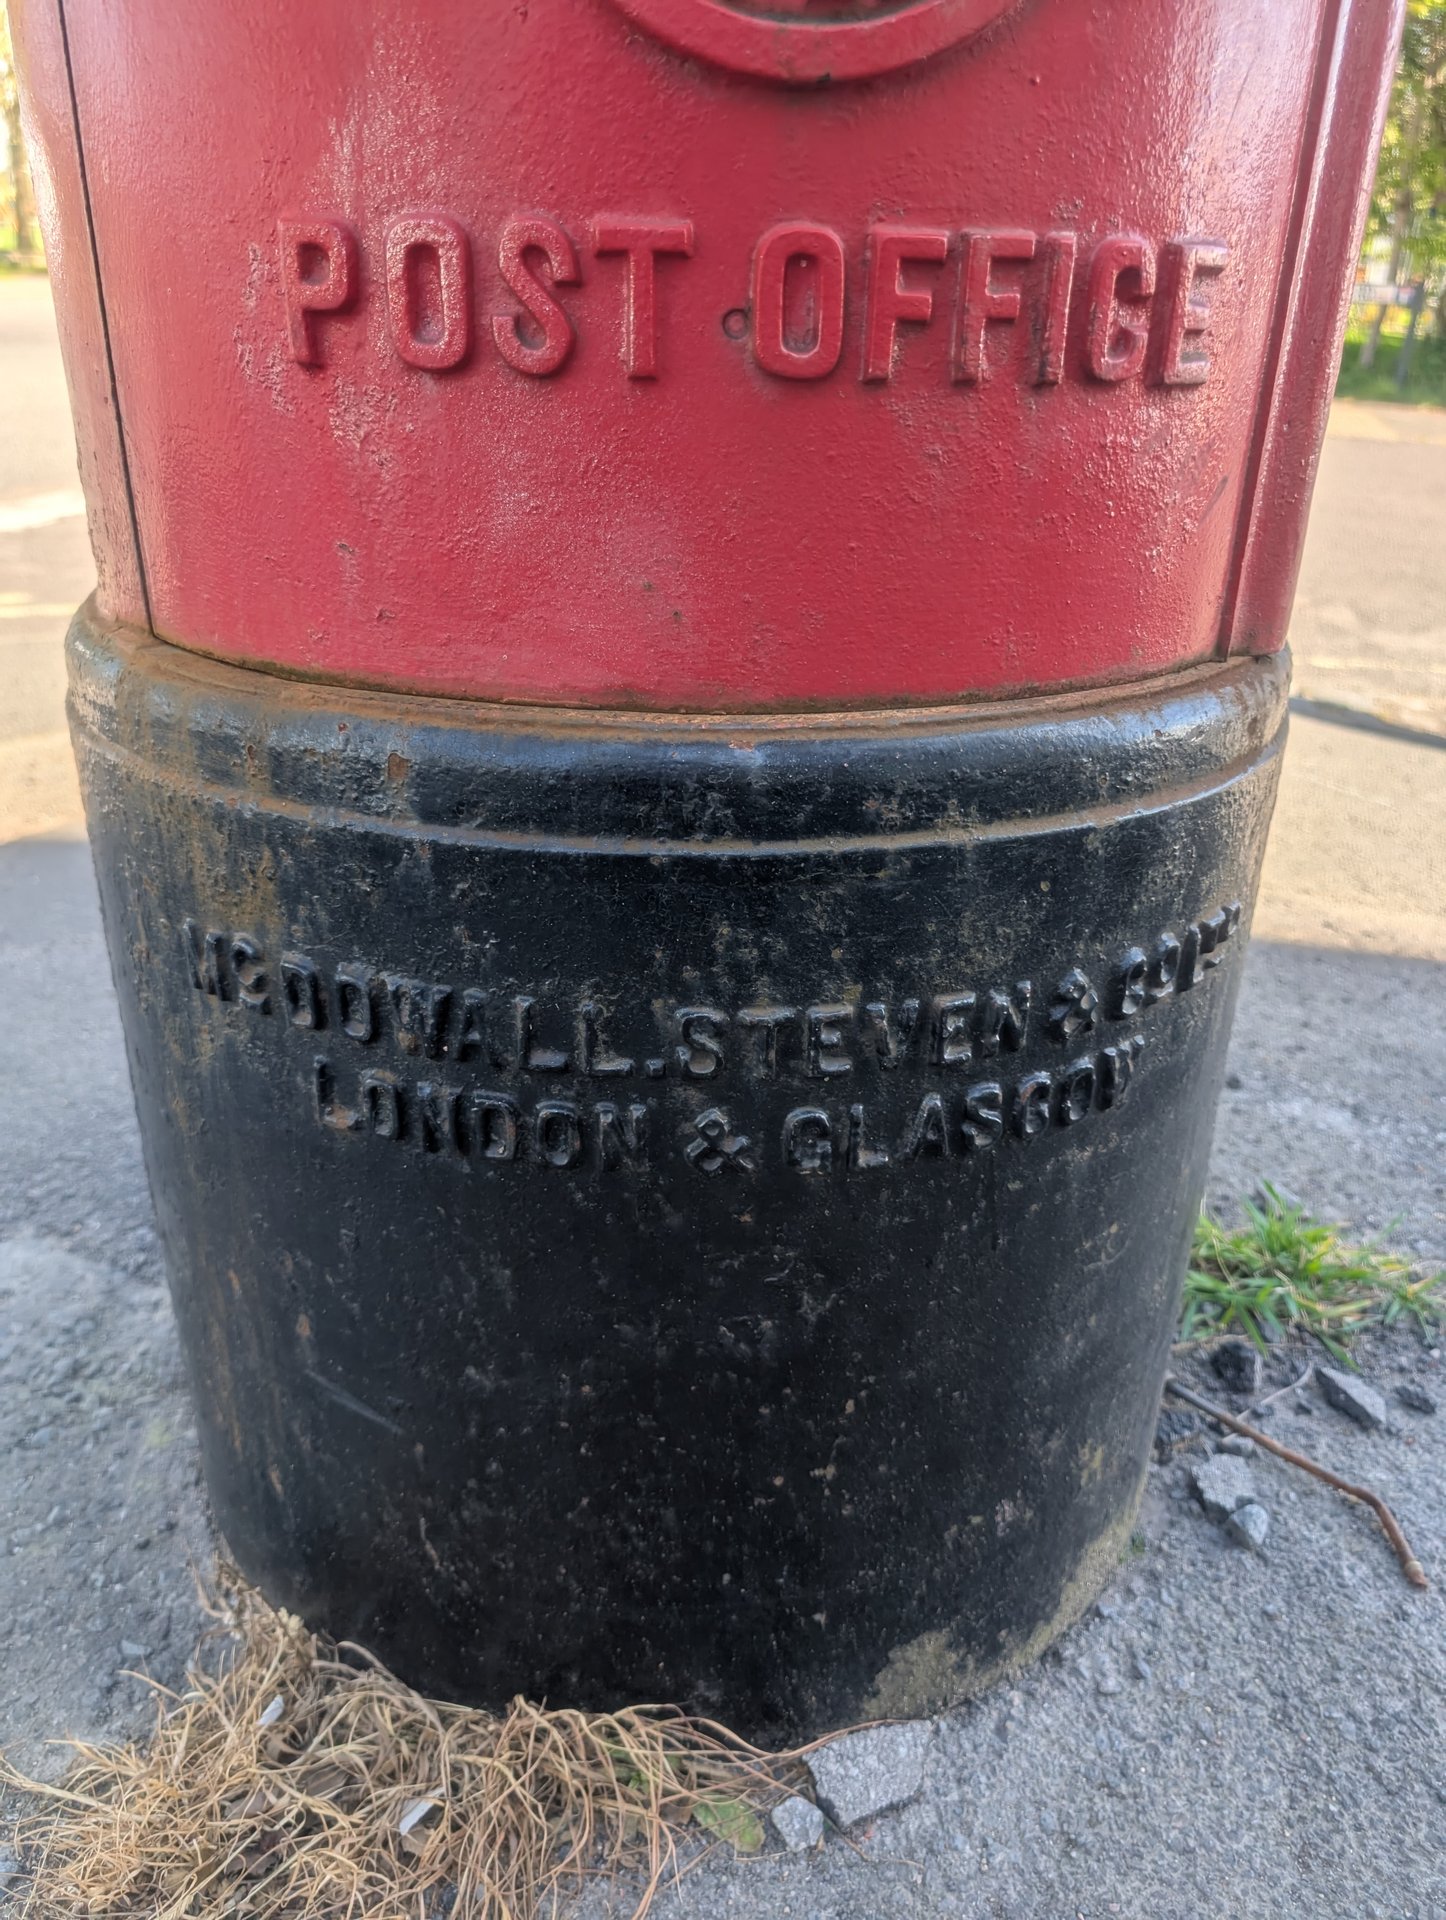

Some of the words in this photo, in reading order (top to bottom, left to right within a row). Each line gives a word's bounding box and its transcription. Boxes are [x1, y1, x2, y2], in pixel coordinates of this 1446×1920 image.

[278, 211, 695, 382] POST
[748, 219, 1230, 387] OFFICE
[311, 1053, 647, 1170] LONDON
[684, 1106, 758, 1174] &
[781, 1034, 1146, 1174] GLASGOW
